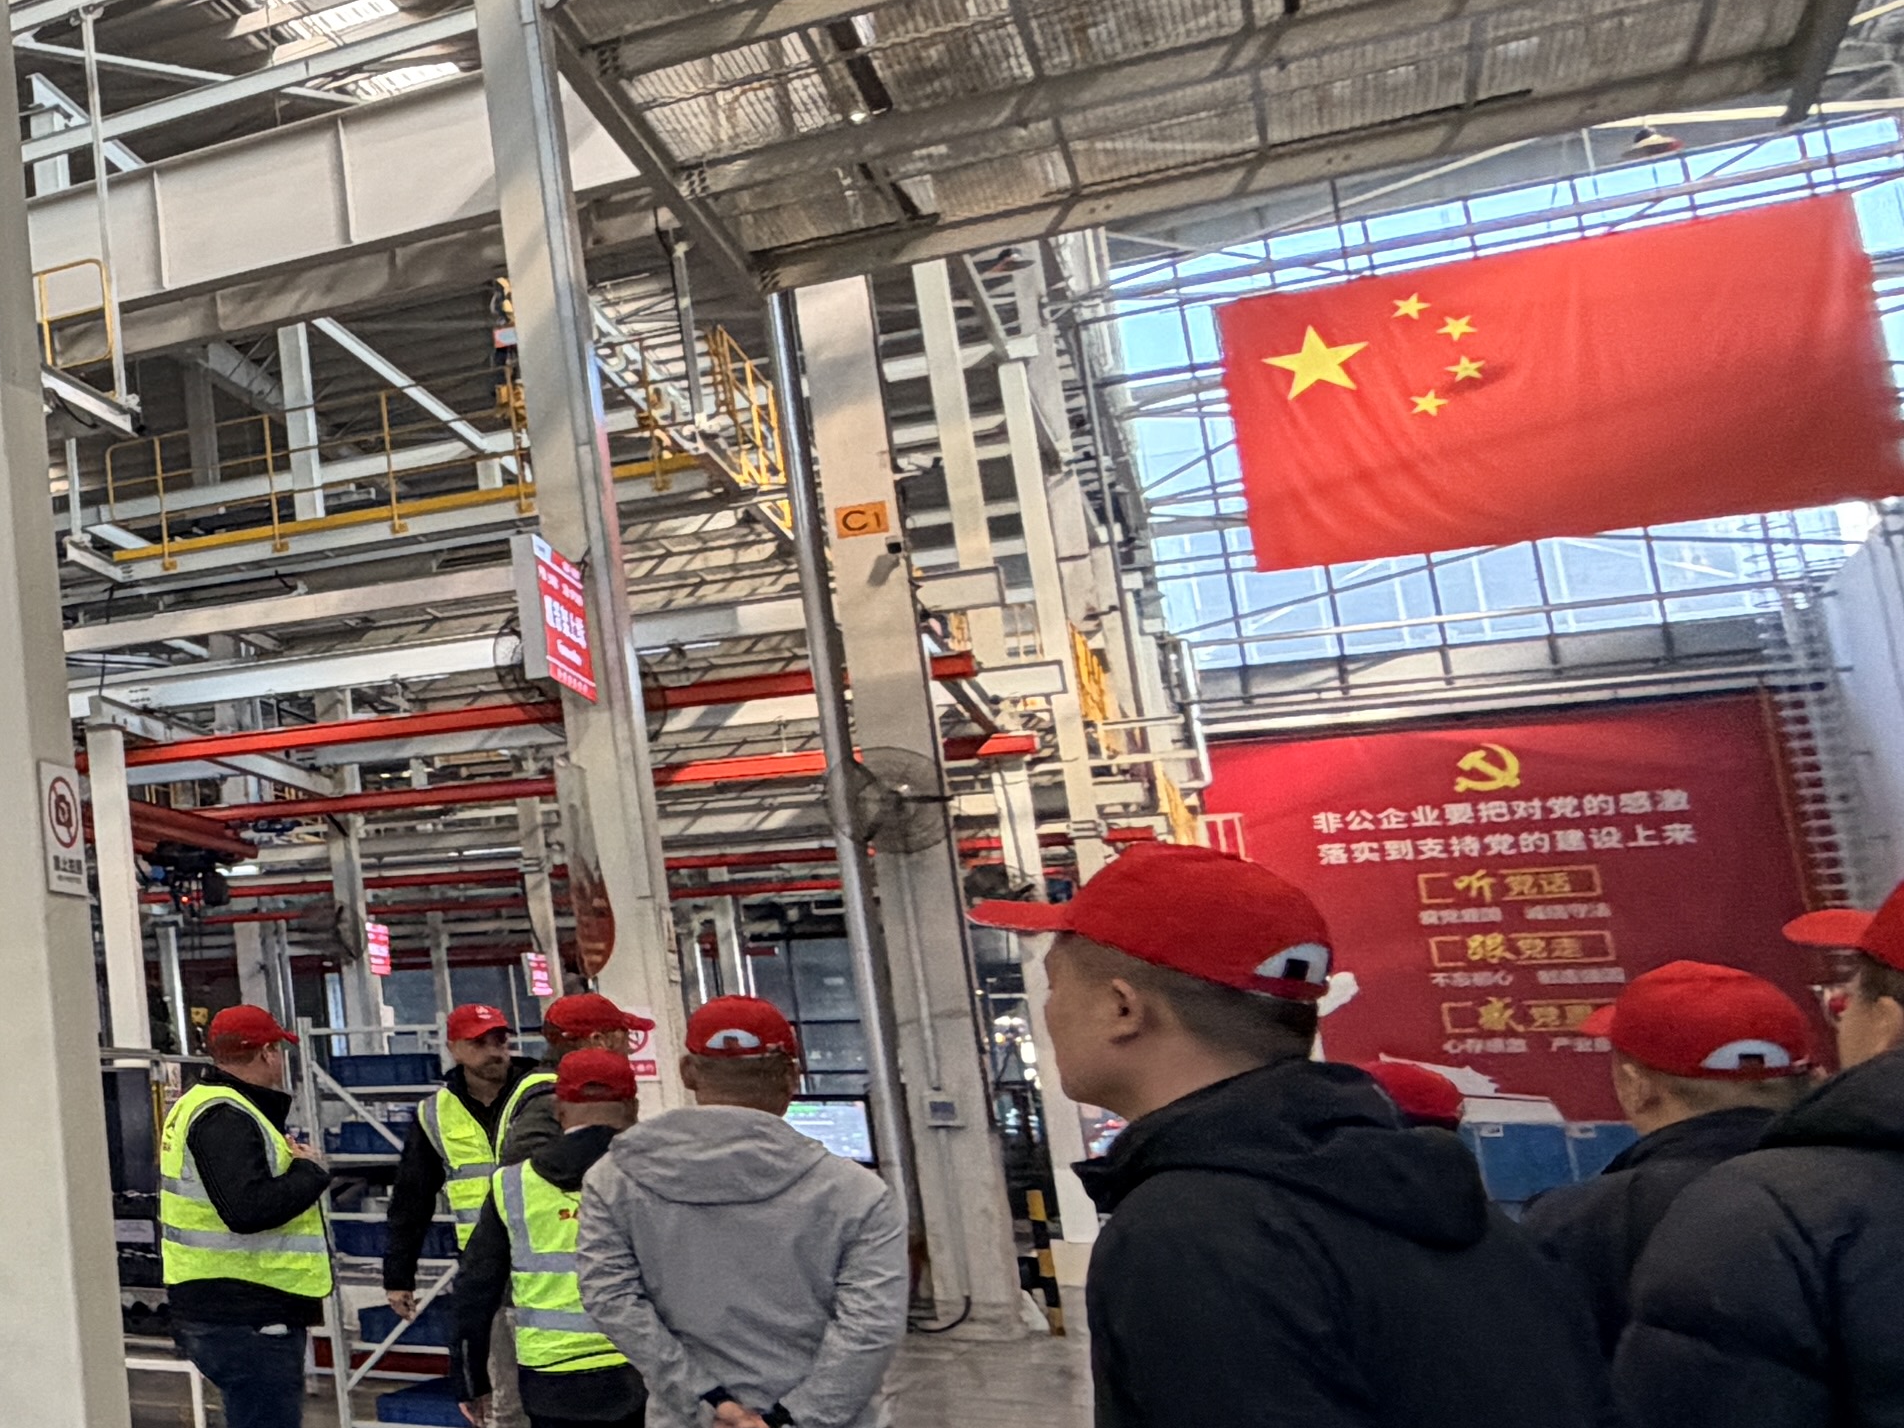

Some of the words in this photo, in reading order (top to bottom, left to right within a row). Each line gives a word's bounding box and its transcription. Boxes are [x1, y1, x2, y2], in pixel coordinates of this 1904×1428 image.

[1312, 788, 1690, 835] 非公企业要把对党的感激
[1318, 822, 1698, 866] 落实到支持党的建设上来
